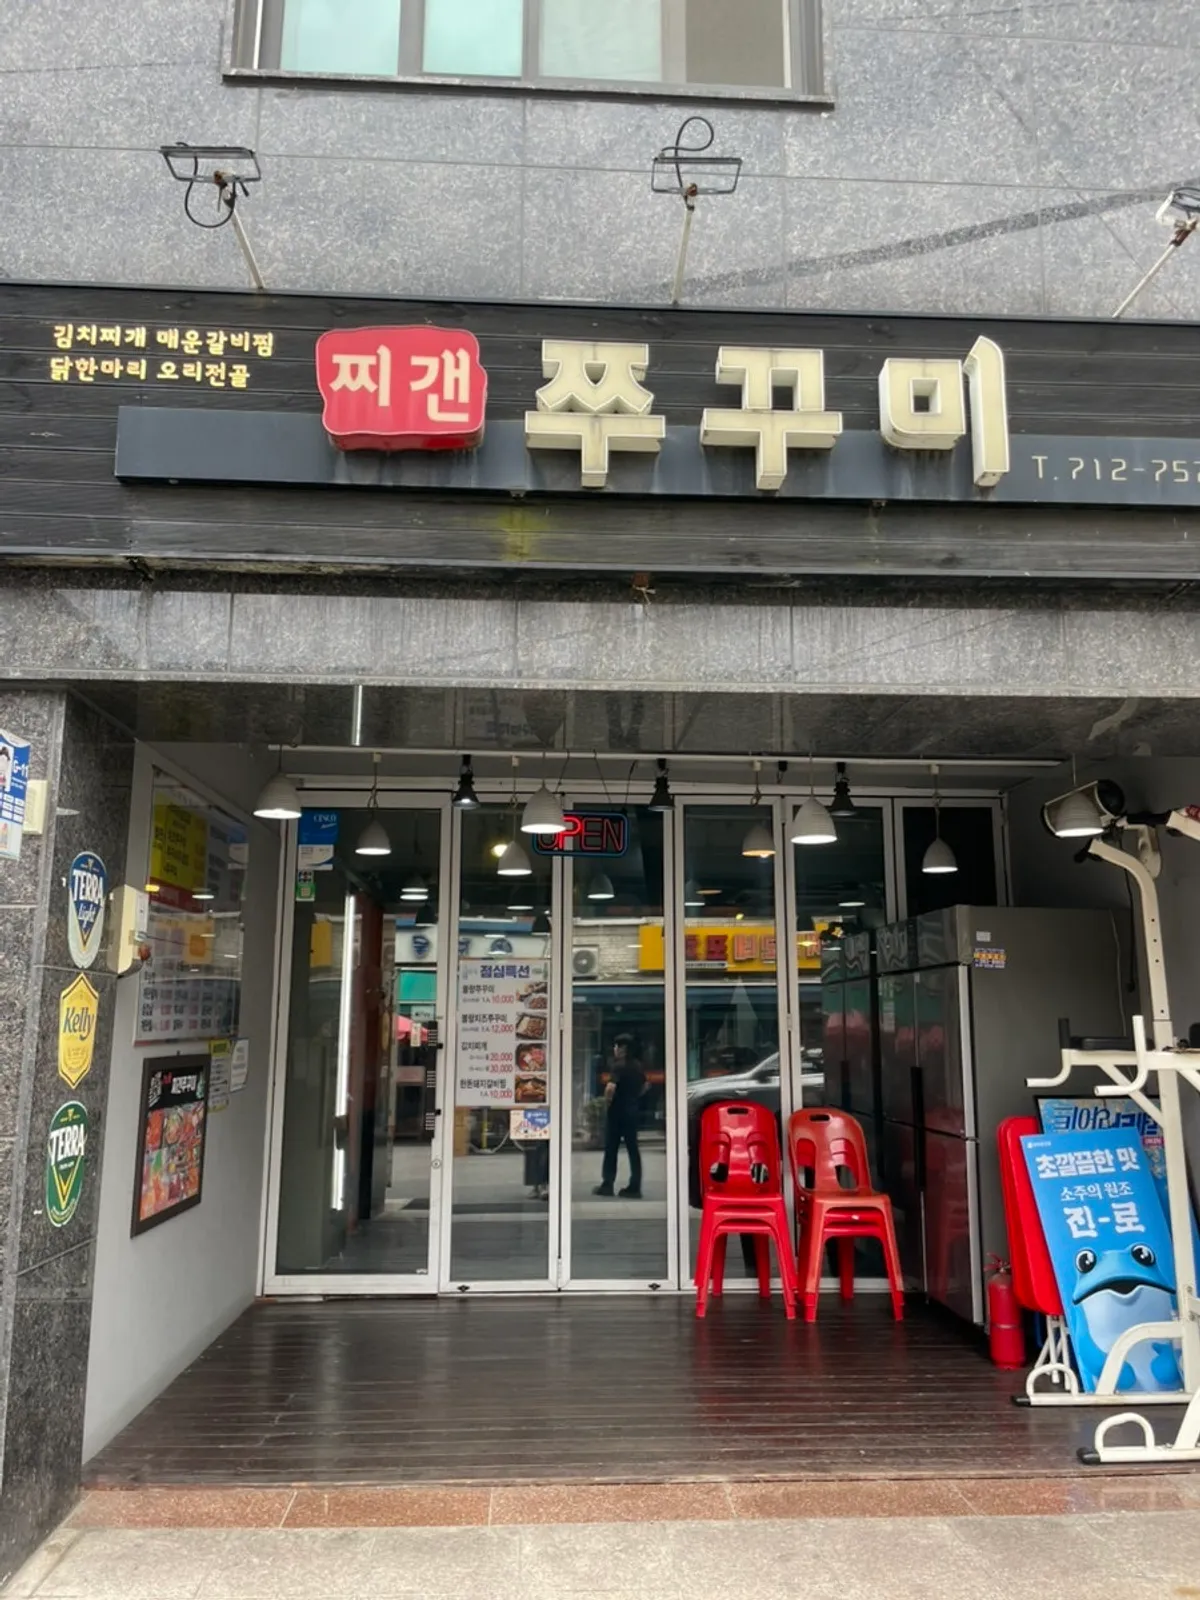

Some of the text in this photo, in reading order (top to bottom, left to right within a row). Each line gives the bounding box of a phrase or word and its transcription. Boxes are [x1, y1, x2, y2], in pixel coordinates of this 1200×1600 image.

[53, 323, 275, 358] 김치찌개 매운갈비찜
[49, 356, 251, 389] 닭한마리 오리전골
[328, 335, 1010, 490] 찌갠 쭈꾸미
[71, 868, 105, 905] TERRA
[480, 964, 531, 979] 점심특선
[63, 1006, 95, 1041] Kelly
[50, 1122, 85, 1166] TERRA
[1035, 1146, 1140, 1179] 초깔끔한 맛
[1060, 1180, 1134, 1202] 소주의 원조
